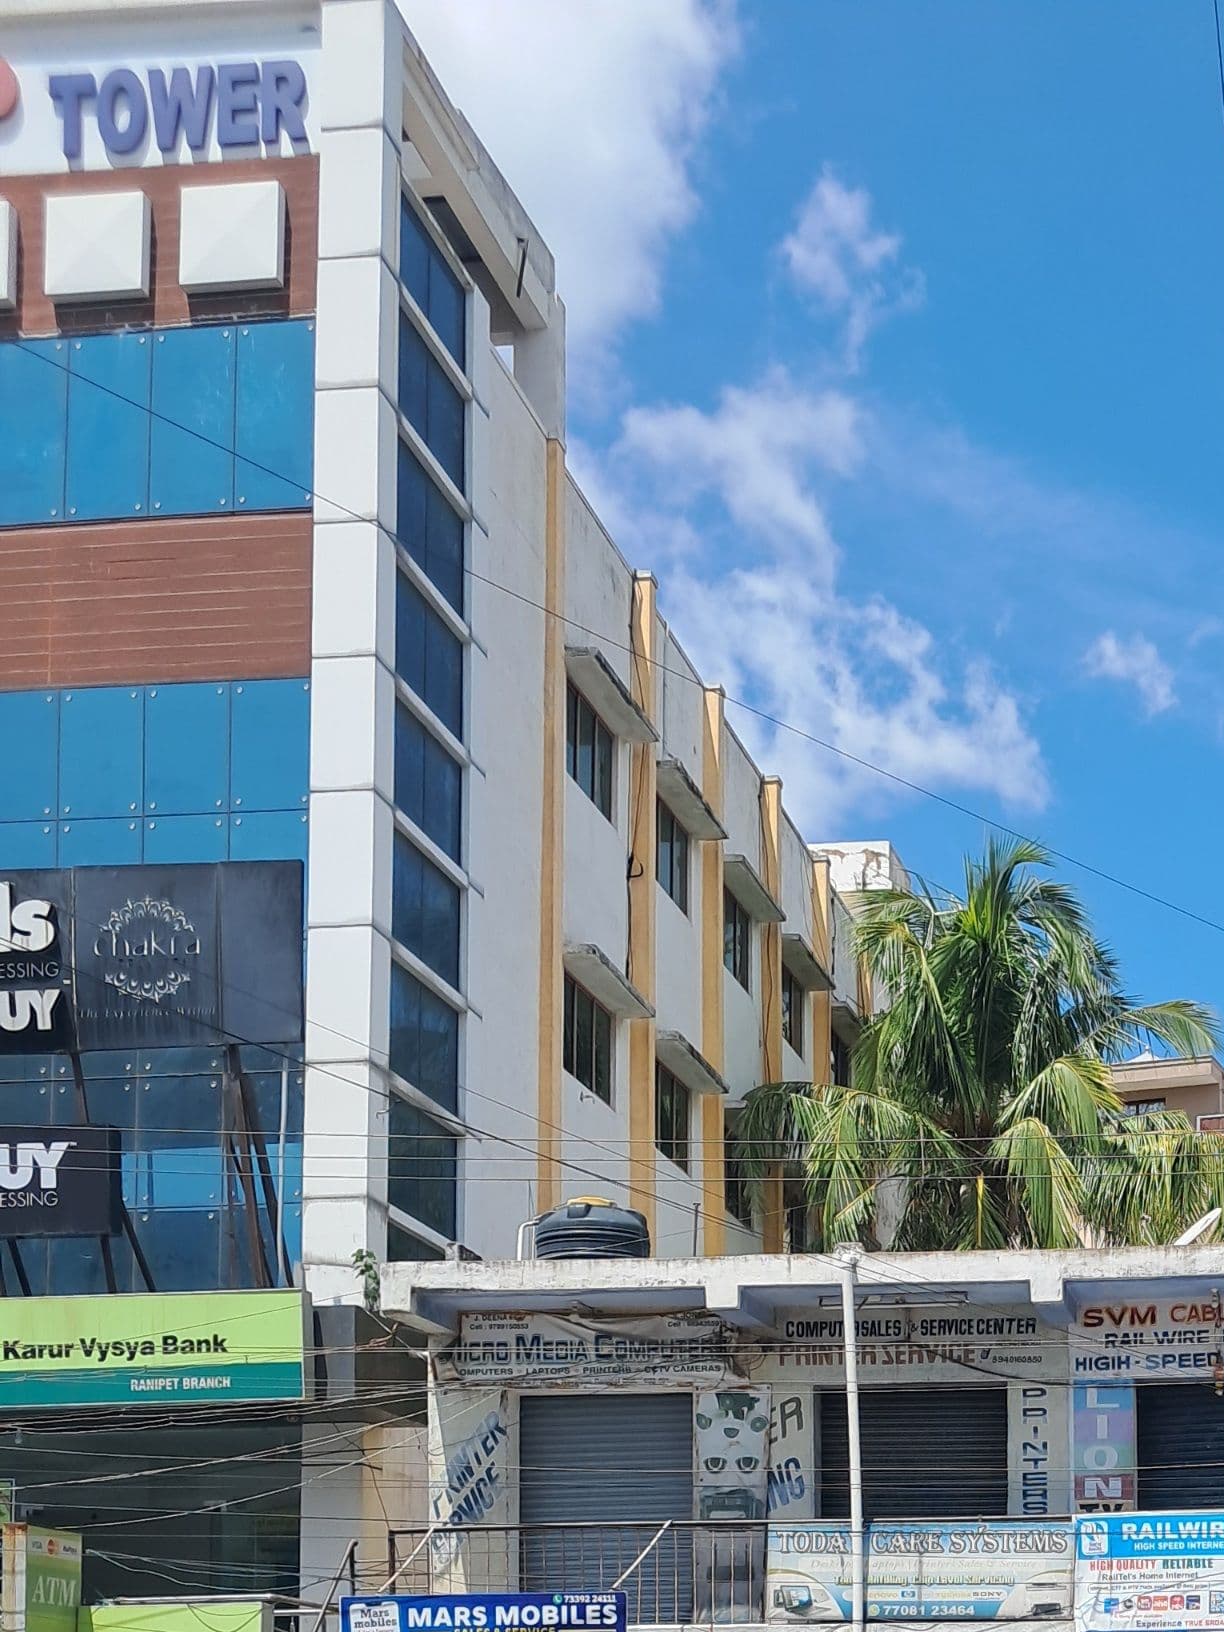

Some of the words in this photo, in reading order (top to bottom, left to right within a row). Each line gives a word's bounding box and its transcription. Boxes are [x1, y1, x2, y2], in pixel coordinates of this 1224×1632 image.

[50, 60, 307, 158] TOWER
[1083, 1305, 1157, 1328] SVM
[786, 1320, 861, 1338] COMPUTR
[862, 1320, 902, 1337] SALES
[920, 1318, 974, 1337] SERVICE
[976, 1317, 1037, 1336] CENTER
[3, 1339, 74, 1361] Karur
[79, 1337, 156, 1363] Vysya
[162, 1333, 229, 1355] Bank
[515, 1333, 588, 1361] MEDIA
[1104, 1329, 1209, 1349] RAILWIRE
[525, 1366, 570, 1375] LAPTOPS
[672, 1364, 721, 1373] CAMERAS
[131, 1378, 179, 1392] RANIPET
[182, 1375, 232, 1390] BRANCH
[776, 1530, 854, 1554] TODA
[871, 1530, 944, 1554] CARE
[949, 1525, 1068, 1554] SYSTEMS
[1134, 1541, 1155, 1551] HIGH
[1157, 1541, 1185, 1550] SPEED
[1089, 1560, 1115, 1571] HIGH
[1116, 1559, 1156, 1571] QUALITY
[1162, 1558, 1214, 1570] RELIABLE
[1139, 1572, 1163, 1580] Home
[1165, 1571, 1199, 1579] Internet
[32, 1575, 77, 1608] ATM
[360, 1608, 390, 1618] Mars
[408, 1605, 488, 1628] MARS
[495, 1603, 618, 1627] MOBILES
[883, 1605, 926, 1616] 77081
[931, 1605, 975, 1616] 23464
[354, 1617, 398, 1629] mobiles
